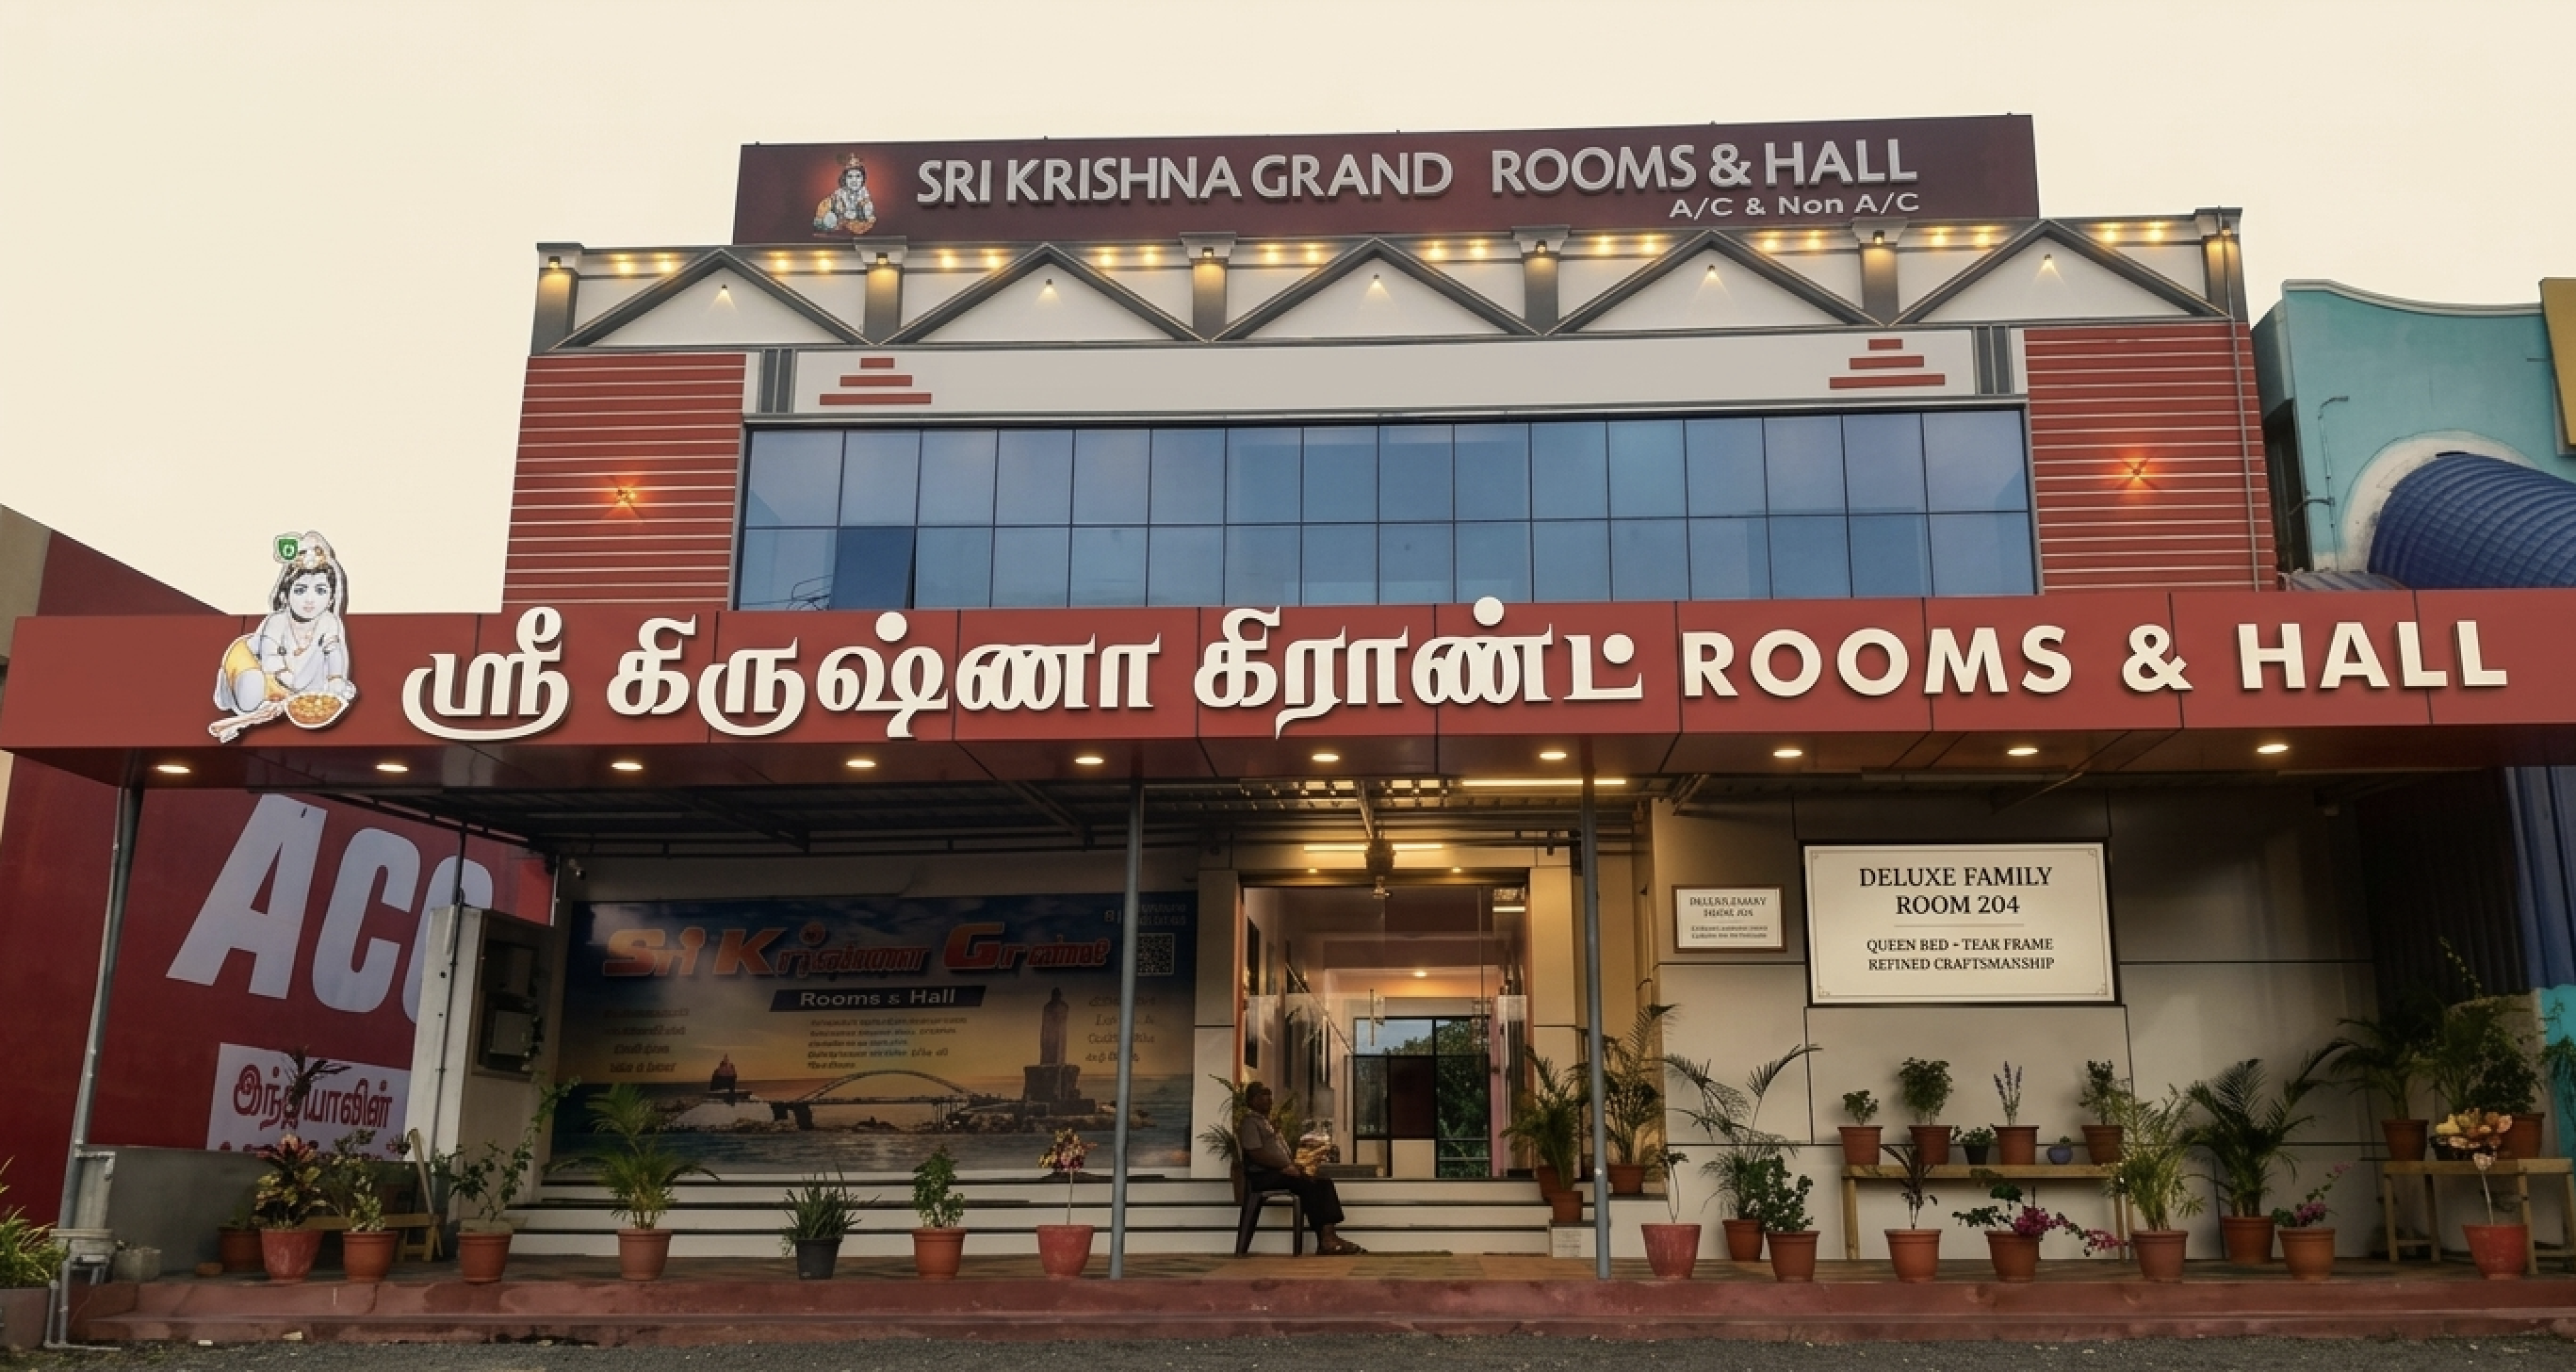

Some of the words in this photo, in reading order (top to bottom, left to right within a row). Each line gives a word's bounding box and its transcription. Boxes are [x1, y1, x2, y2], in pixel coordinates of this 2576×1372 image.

[917, 158, 992, 204] SRI
[1005, 155, 1242, 204] KRISHNA
[1250, 151, 1454, 199] GRAND
[1492, 144, 1697, 194] ROOMS
[1708, 142, 1752, 188] &
[1765, 139, 1918, 186] HALL
[1670, 197, 1734, 220] A/C
[1745, 197, 1766, 216] &
[1778, 195, 1844, 216] Non
[1854, 192, 1919, 215] A/C
[606, 611, 1163, 740] கிருஷ்ணா
[1194, 596, 1643, 740] கிராண்ட்
[1681, 624, 2073, 697] ROOMS
[2121, 623, 2193, 693] &
[2237, 619, 2508, 691] HALL
[1859, 867, 1957, 887] DELUXE
[1964, 866, 2053, 887] FAMILY
[1895, 894, 1972, 915] ROOM
[1977, 894, 2021, 915] 204
[1867, 939, 1917, 955] QUEEN
[1919, 939, 1949, 951] BED
[2003, 938, 2055, 951] FRAME
[1867, 957, 1932, 971] REFINED
[1932, 956, 2055, 971] CRAFTSMANSHIP
[800, 992, 881, 1006] Rooms
[909, 988, 955, 1004] Hall
[234, 1064, 393, 1131] இந்தயாவின்
